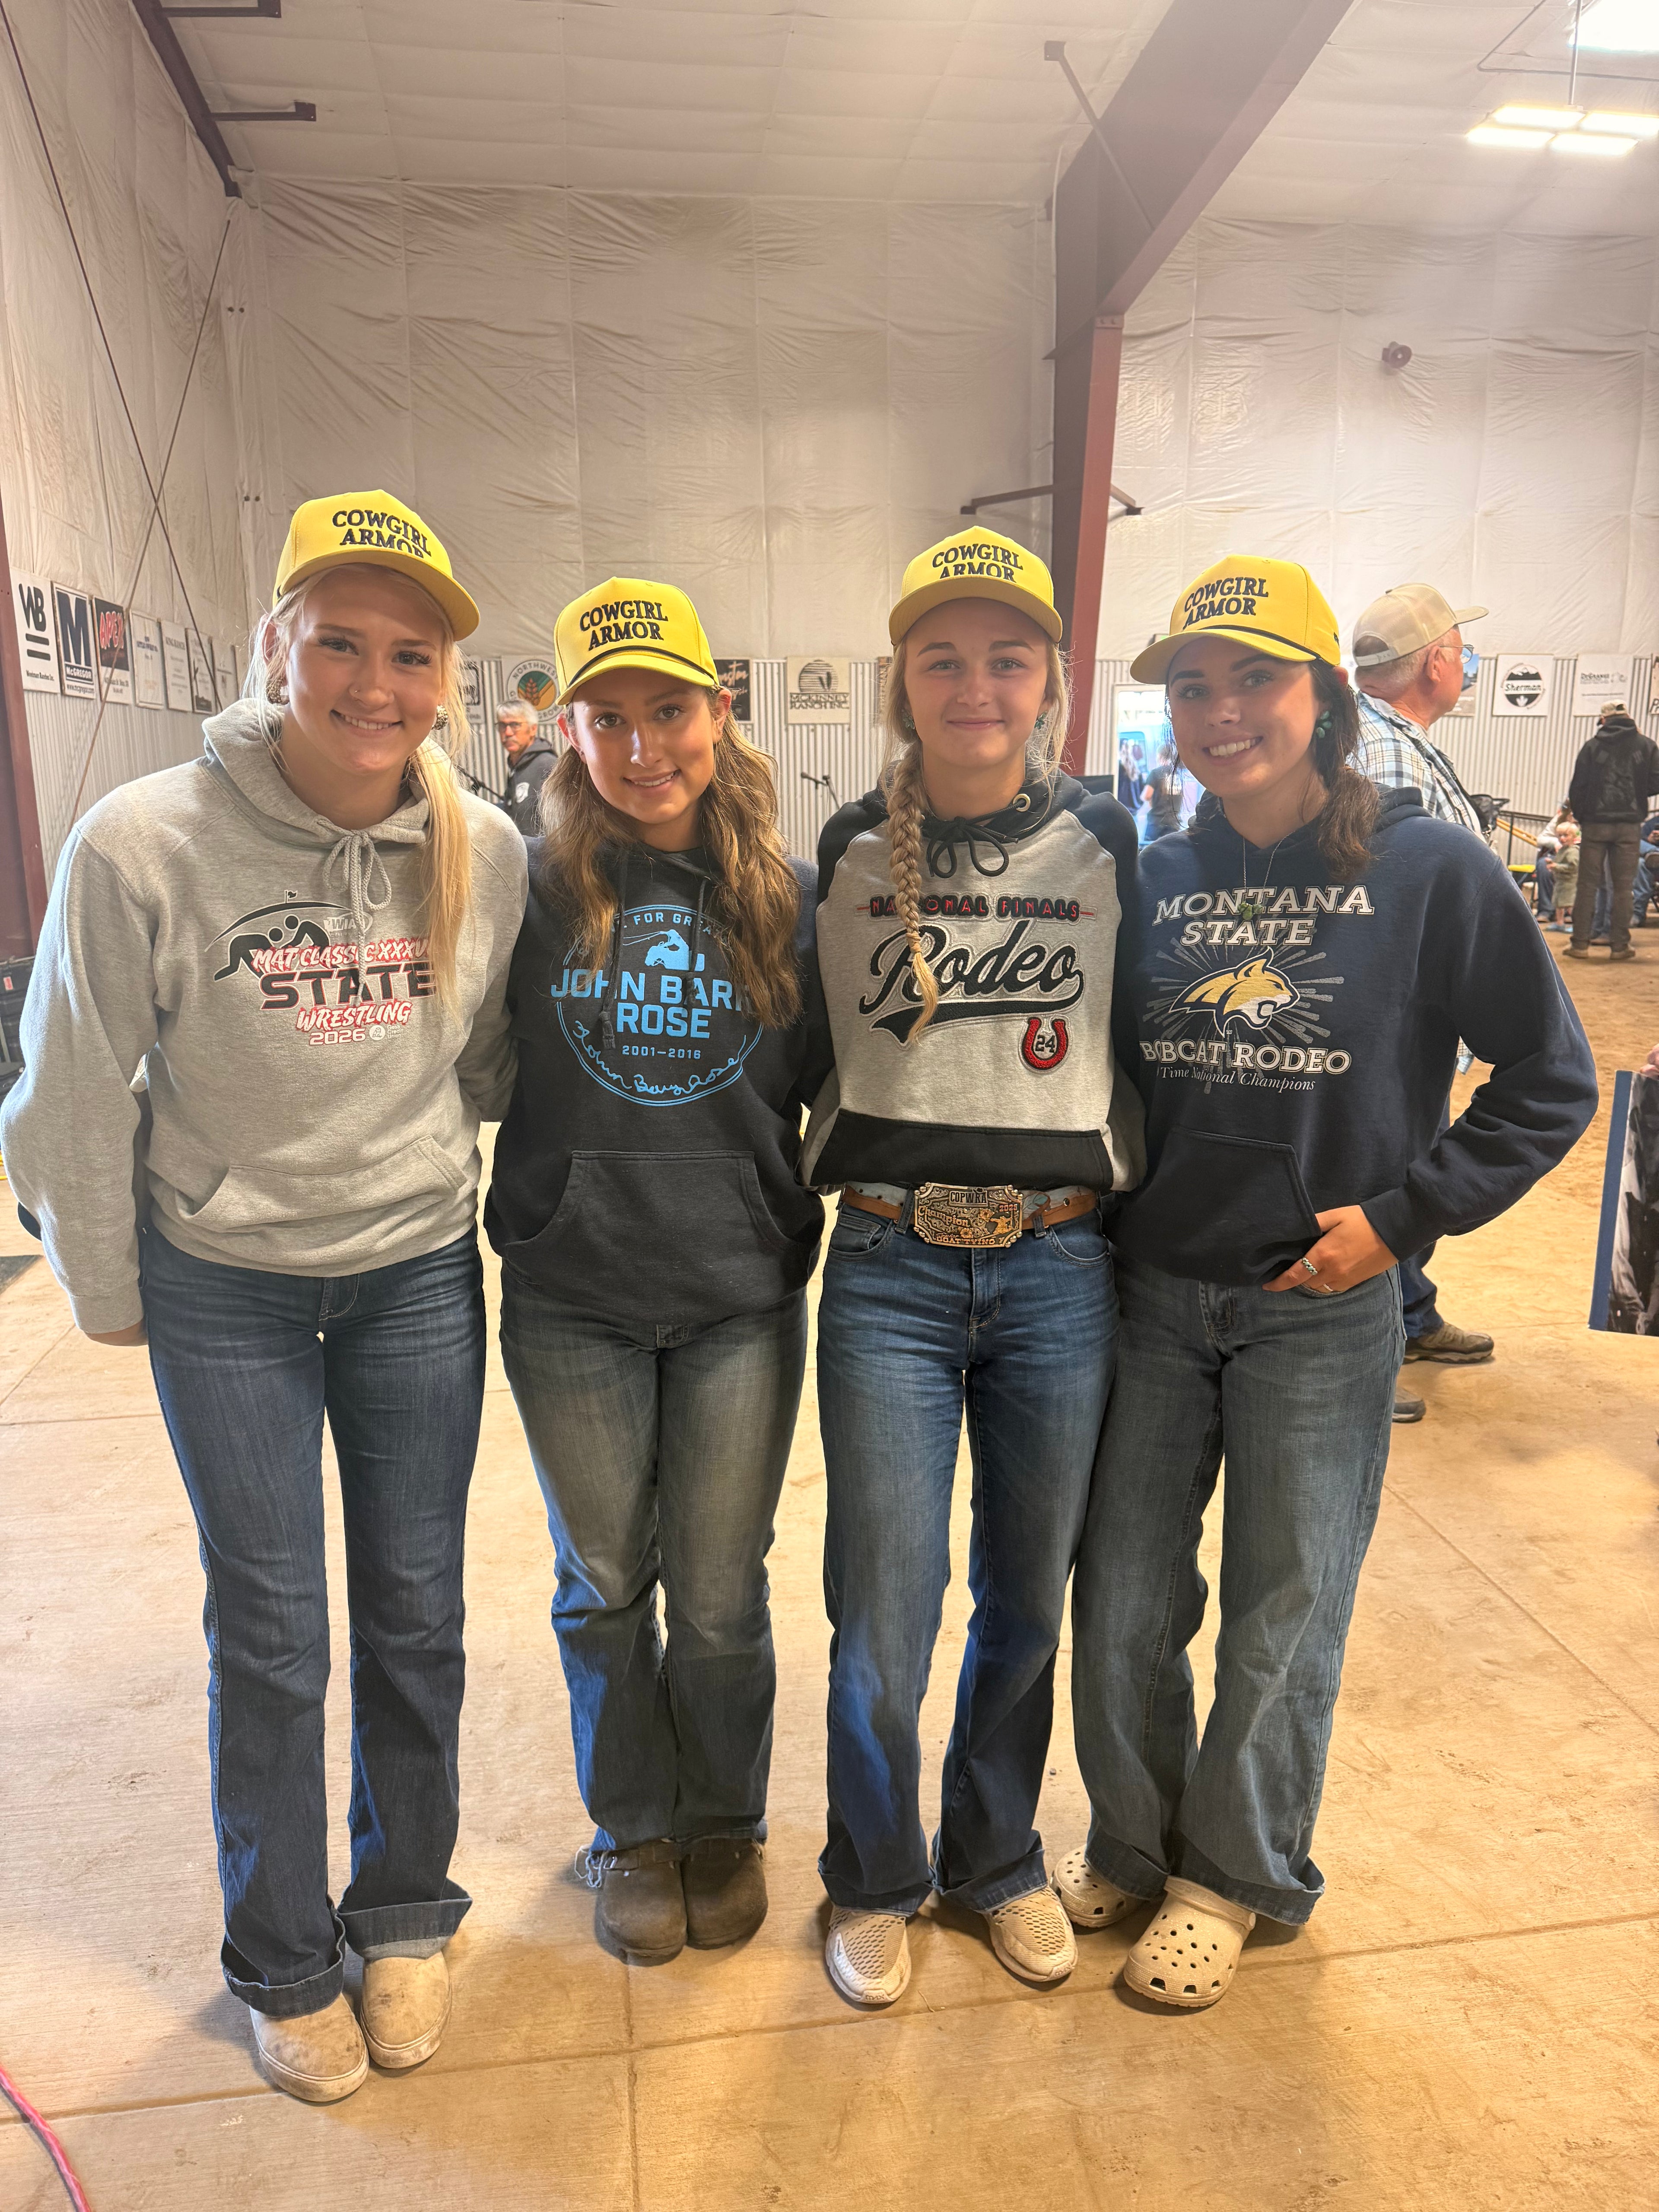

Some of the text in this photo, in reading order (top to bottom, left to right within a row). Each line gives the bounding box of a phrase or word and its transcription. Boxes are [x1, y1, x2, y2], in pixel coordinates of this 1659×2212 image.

[332, 509, 431, 557] COWGIRL
[932, 543, 1023, 570] COWGIRL
[940, 562, 1017, 583] ARMOR
[19, 583, 46, 632] WB
[1185, 577, 1268, 612] COWGIRL
[580, 600, 668, 632] COWGIRL
[1182, 597, 1256, 630] ARMOR
[57, 591, 92, 667] M
[588, 621, 664, 651] ARMOR
[67, 667, 92, 679] McGREGOR
[633, 912, 664, 925] FOR
[871, 896, 1079, 921] NAONAL FINALS
[1153, 885, 1375, 926] MONTANA
[1180, 918, 1316, 946] STATE
[253, 947, 299, 972] MAT
[300, 942, 375, 969] CLASSC
[859, 919, 1080, 1014] Rodeo
[259, 961, 435, 1010] STATE
[660, 975, 741, 1011] BAR
[296, 1001, 412, 1032] WRESTLING
[617, 1002, 712, 1039] ROSE
[309, 1028, 366, 1046] 2026
[1035, 1035, 1055, 1053] 24
[1231, 1042, 1351, 1074] RODEO
[1161, 1067, 1189, 1078] Time
[1192, 1067, 1236, 1084] National
[1240, 1072, 1316, 1093] Champions
[918, 1205, 970, 1227] Champion
[999, 1204, 1017, 1212] 2025
